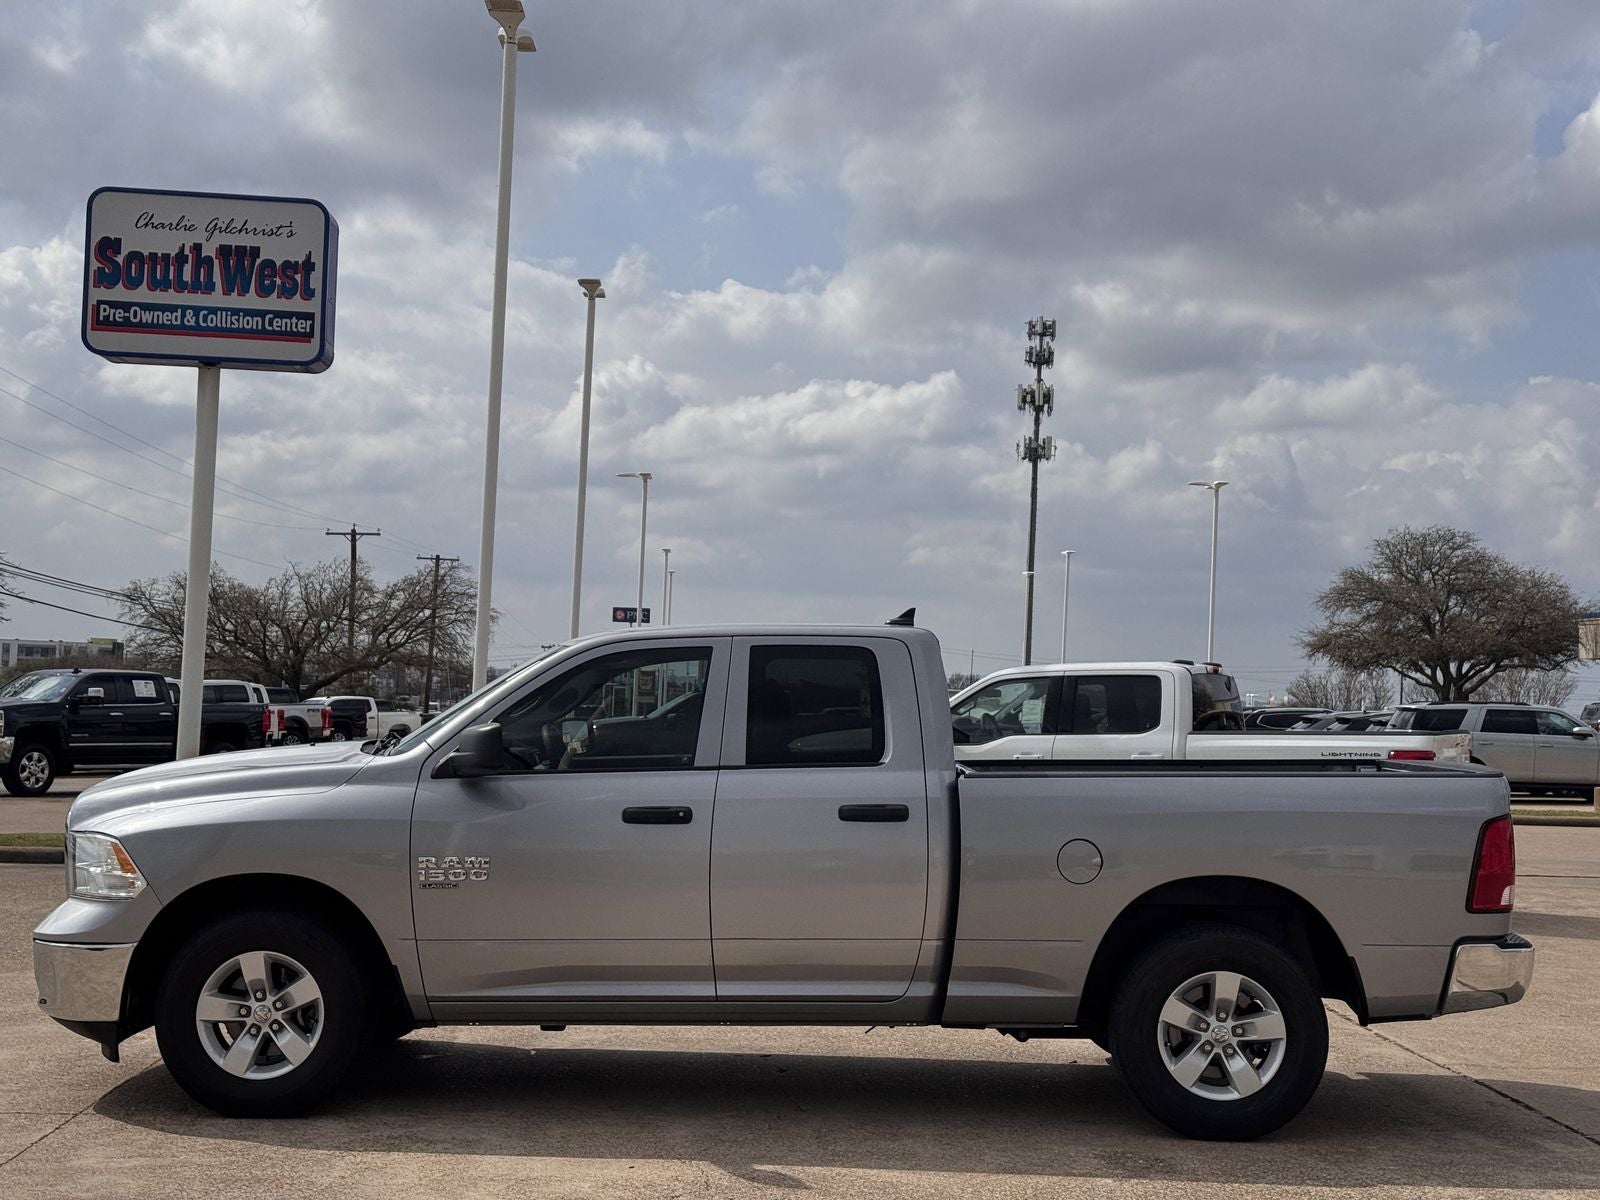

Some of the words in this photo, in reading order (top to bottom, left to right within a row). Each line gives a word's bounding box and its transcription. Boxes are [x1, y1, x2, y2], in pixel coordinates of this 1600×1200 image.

[135, 211, 198, 232] Charlie
[204, 217, 297, 242] Gilchrist's
[93, 235, 316, 300] SouthWest
[99, 304, 181, 326] Pre-Owned
[183, 309, 196, 327] &
[199, 310, 262, 331] Collision
[264, 314, 313, 334] Center
[417, 869, 488, 881] 1500
[418, 856, 489, 868] RAM
